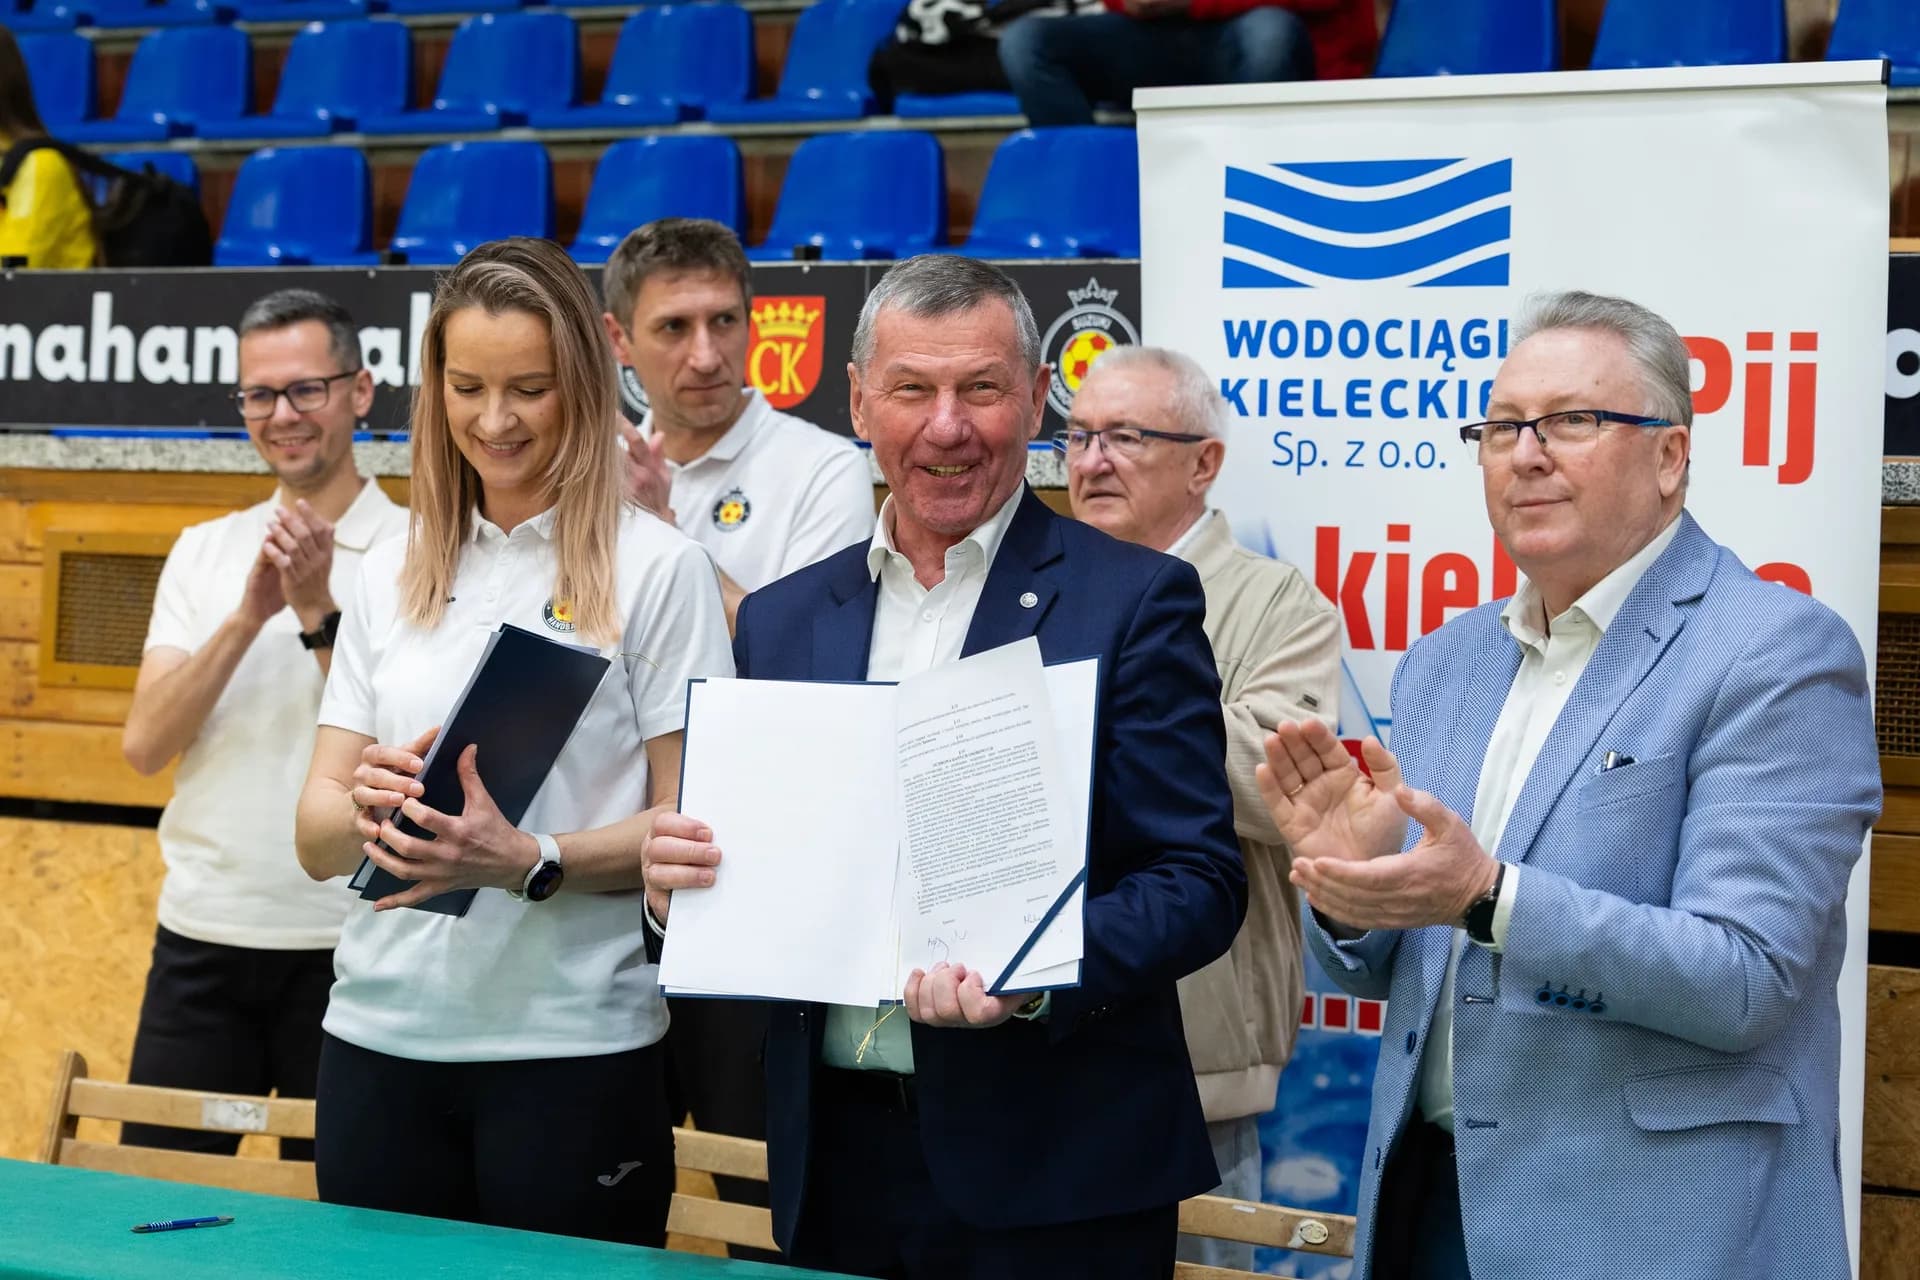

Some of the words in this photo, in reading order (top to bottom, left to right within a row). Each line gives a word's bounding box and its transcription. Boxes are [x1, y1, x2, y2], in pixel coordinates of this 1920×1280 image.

[749, 340, 808, 395] CK
[1223, 319, 1509, 372] WODOCIĄGI
[1272, 431, 1328, 476] Sp.
[1345, 441, 1365, 467] z
[1379, 441, 1446, 469] o.o.
